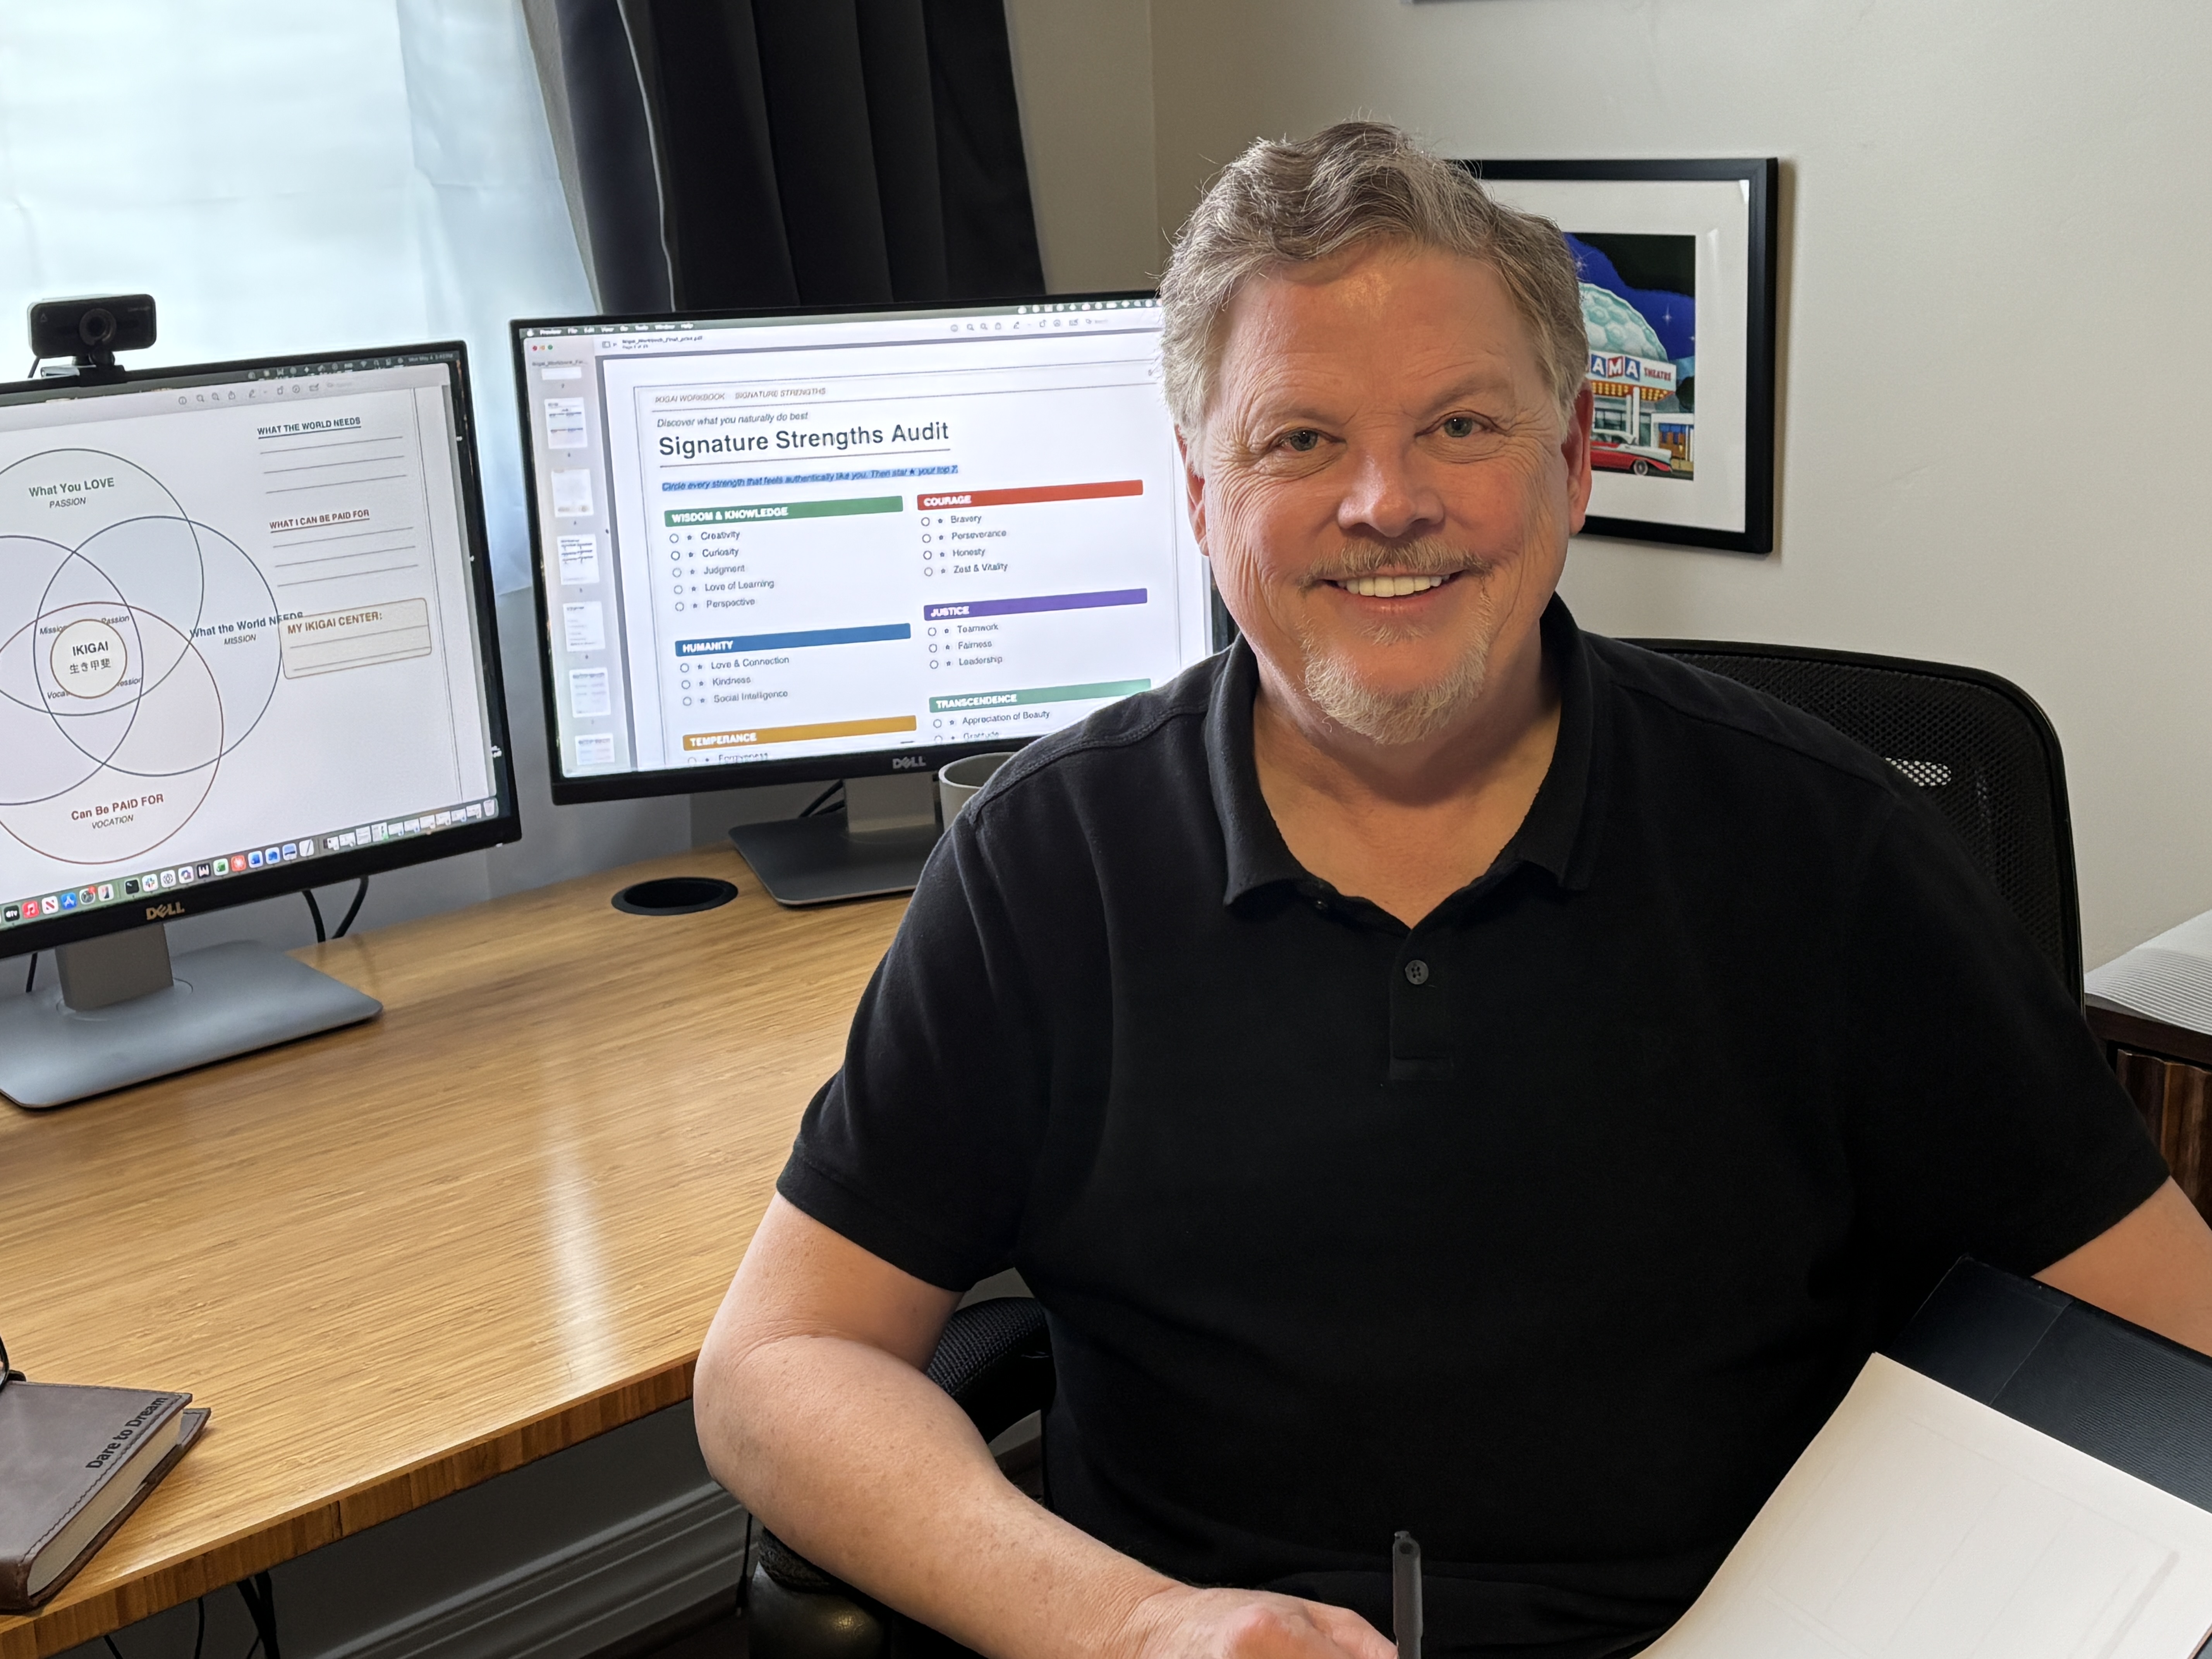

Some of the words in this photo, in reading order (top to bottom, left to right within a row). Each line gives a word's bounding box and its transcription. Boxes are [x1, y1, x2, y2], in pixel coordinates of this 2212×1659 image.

[1592, 357, 1639, 379] AMA
[680, 393, 725, 402] WORKBOOK
[258, 425, 281, 435] WHAT
[284, 423, 300, 433] THE
[302, 420, 332, 431] WORLD
[333, 417, 361, 427] NEEDS
[657, 418, 695, 428] Discover
[697, 416, 718, 425] what
[720, 417, 736, 426] you
[738, 413, 775, 424] naturally
[776, 413, 788, 422] do
[790, 412, 809, 421] best
[659, 434, 769, 459] Signature
[776, 426, 884, 450] Strengths
[891, 421, 949, 442] Audit
[28, 484, 58, 497] What
[60, 483, 81, 493] You
[84, 477, 115, 491] LOVE
[662, 482, 685, 491] Circle
[712, 478, 745, 488] strength
[747, 477, 763, 486] that
[785, 472, 834, 484] authentically
[871, 470, 890, 479] Then
[49, 497, 86, 508] PASSION
[924, 495, 972, 507] COURAGE
[269, 519, 294, 529] WHAT
[300, 516, 318, 526] CAN
[319, 514, 331, 523] BE
[332, 511, 351, 521] PAID
[353, 509, 370, 518] FOR
[672, 512, 713, 523] WISDOM
[715, 511, 723, 520] &
[725, 507, 789, 520] KNOWLEDGE
[950, 515, 982, 524] Bravery
[700, 531, 740, 541] Creativity
[951, 530, 1007, 540] Perseverance
[702, 548, 739, 557] Curiosity
[952, 548, 986, 557] Honesty
[703, 565, 745, 576] Judgment
[953, 565, 971, 574] Zest
[981, 563, 1008, 572] Vitality
[704, 583, 725, 592] Love
[727, 581, 736, 589] of
[738, 580, 775, 589] Learning
[706, 598, 756, 609] Perspective
[931, 606, 970, 617] JUSTICE
[189, 627, 216, 638] What
[218, 623, 234, 633] the
[237, 617, 266, 630] World
[287, 623, 305, 634] MY
[305, 617, 336, 632] IKIGAI
[338, 611, 382, 626] CENTER:
[957, 623, 999, 634] Teamwork
[224, 634, 257, 646] MISSION
[958, 641, 993, 650] Fairness
[72, 641, 109, 656] IKIGAI
[682, 641, 733, 653] HUMANITY
[711, 661, 732, 670] Love
[734, 659, 740, 667] &
[742, 656, 790, 667] Connection
[958, 656, 1003, 666] Leadership
[712, 677, 751, 686] Kindness
[714, 693, 739, 703] Social
[741, 690, 788, 701] Intelligence
[936, 694, 1018, 709] TRANSCENDENCE
[962, 713, 1012, 726] Appreciation
[1013, 712, 1020, 720] of
[1023, 710, 1051, 720] Beauty
[690, 732, 757, 747] TEMPERANCE
[892, 756, 927, 769] DELL
[71, 809, 93, 821] Can
[95, 805, 109, 816] Be
[112, 799, 138, 812] PAID
[141, 793, 164, 807] FOR
[91, 814, 134, 829] VOCATION
[146, 902, 185, 921] DELL
[85, 1442, 121, 1468] Dare
[112, 1429, 133, 1440] to
[125, 1397, 169, 1427] Dream
